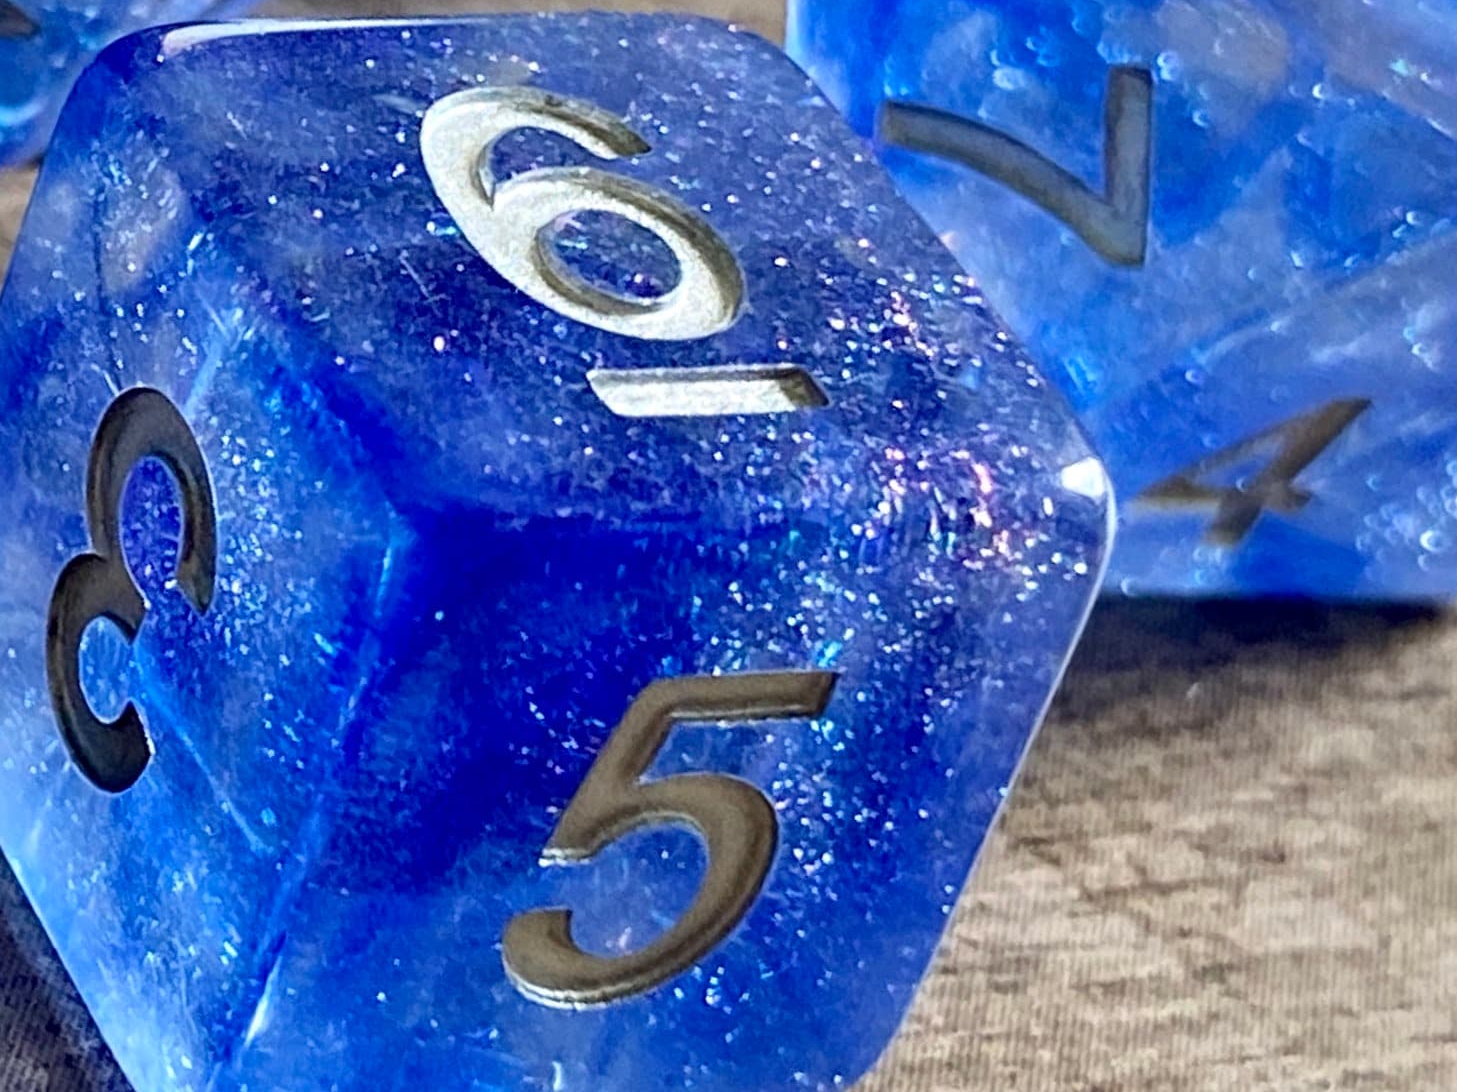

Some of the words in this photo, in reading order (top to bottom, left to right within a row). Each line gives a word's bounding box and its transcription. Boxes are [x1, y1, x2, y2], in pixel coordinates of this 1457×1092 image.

[420, 86, 830, 418] 6
[876, 63, 1153, 267] 7
[46, 386, 218, 795] 3
[1126, 396, 1372, 550] 4
[501, 670, 841, 1012] 5
